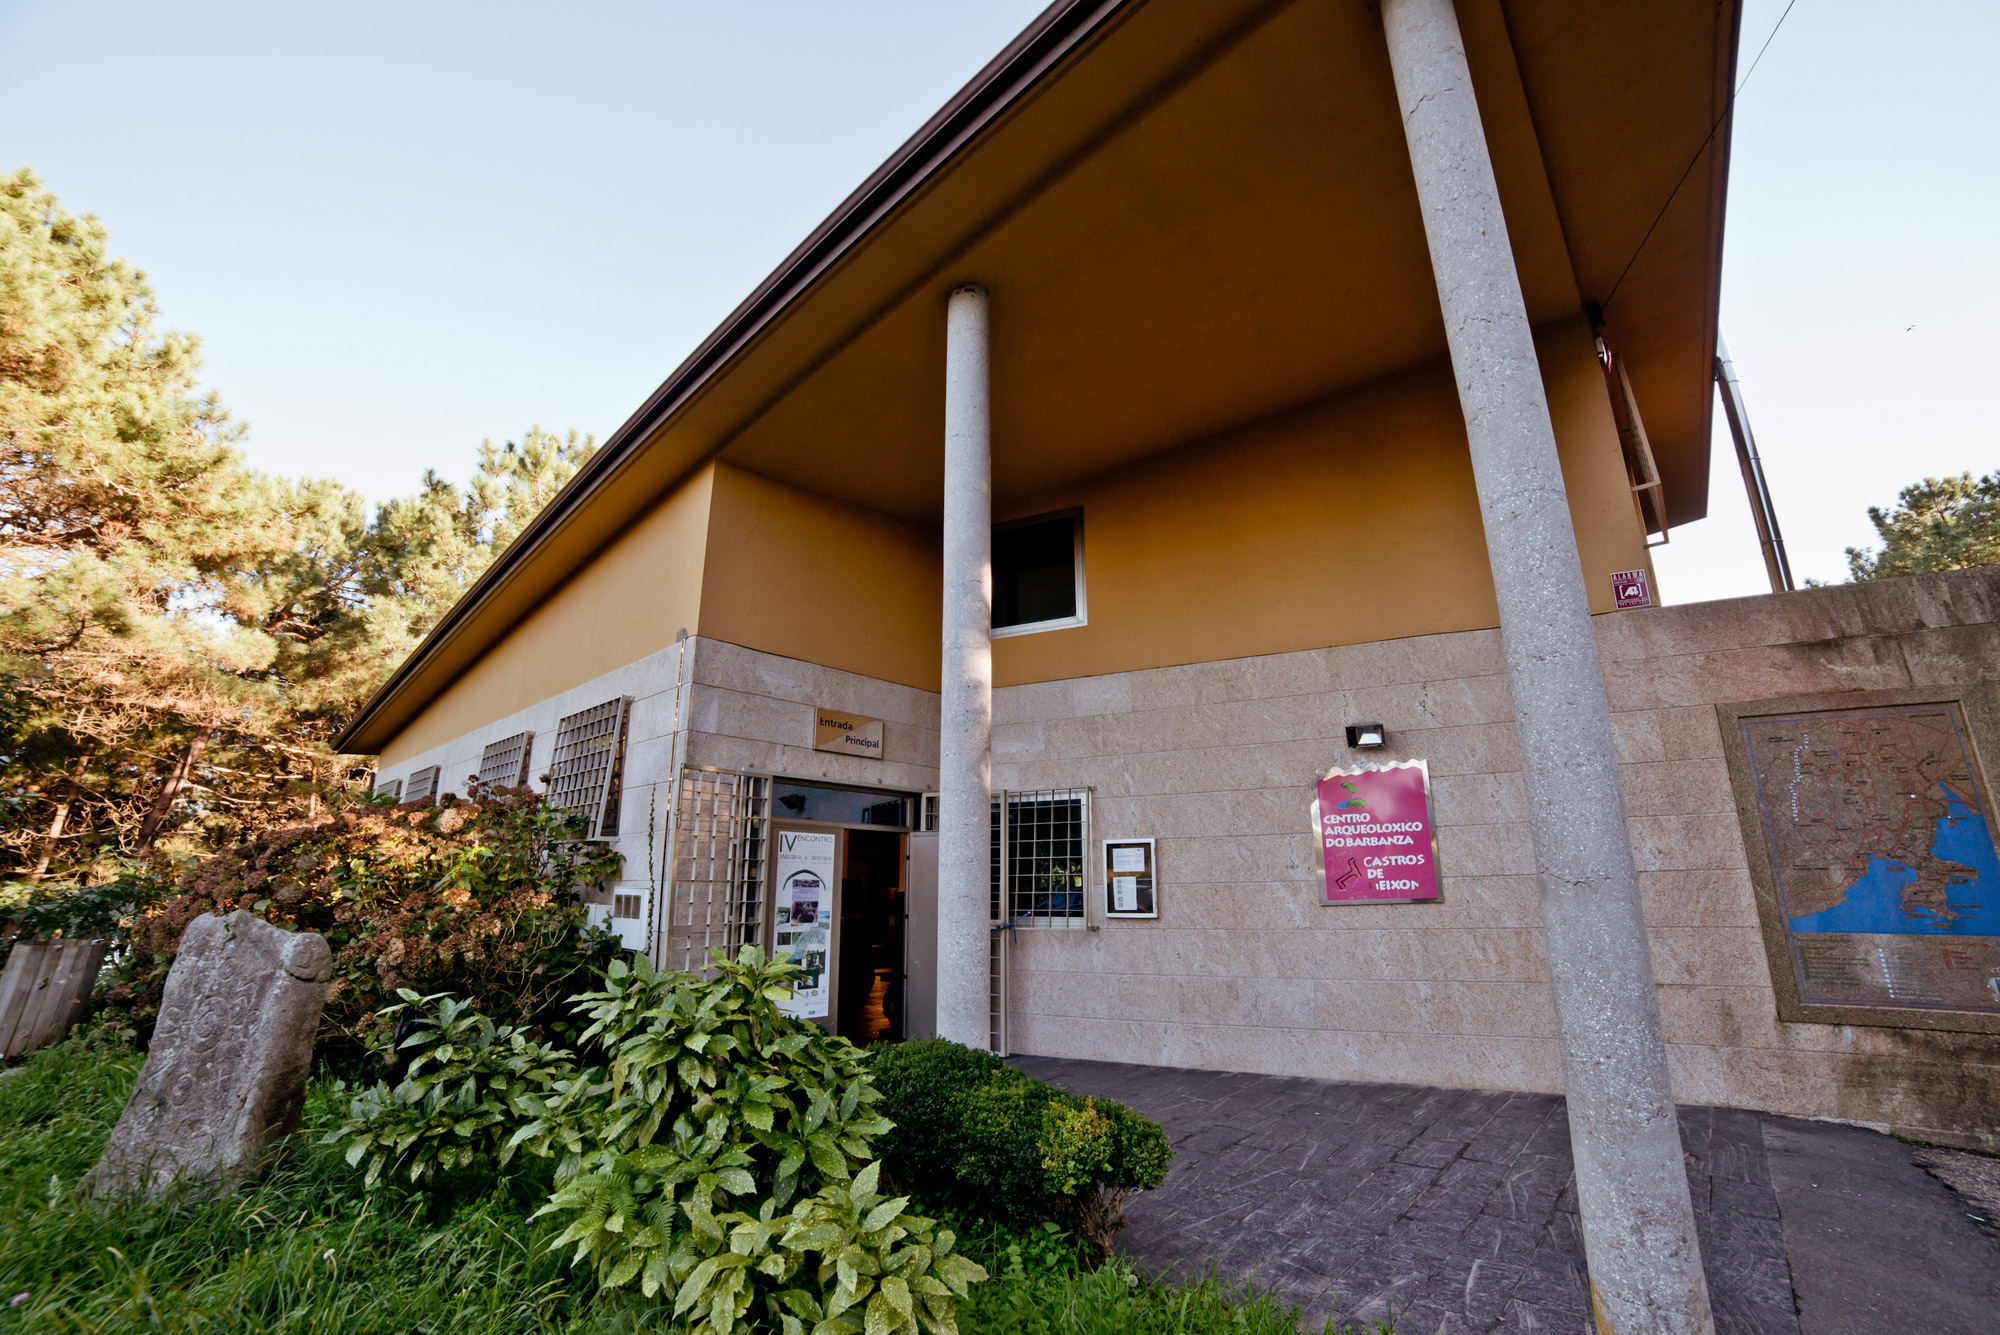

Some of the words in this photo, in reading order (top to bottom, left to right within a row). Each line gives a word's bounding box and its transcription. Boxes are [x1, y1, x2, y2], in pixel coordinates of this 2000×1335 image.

[819, 717, 853, 731] Entrada
[845, 735, 880, 749] Principal
[1323, 813, 1370, 824] CENTRO
[1324, 822, 1423, 836] ARQUEOLOXICO
[779, 833, 798, 852] IV
[797, 835, 833, 843] ENCONTRO
[1325, 837, 1345, 848] DO
[1347, 835, 1414, 847] BARBANZA
[1363, 854, 1425, 867] CASTROS
[1367, 868, 1384, 879] DE
